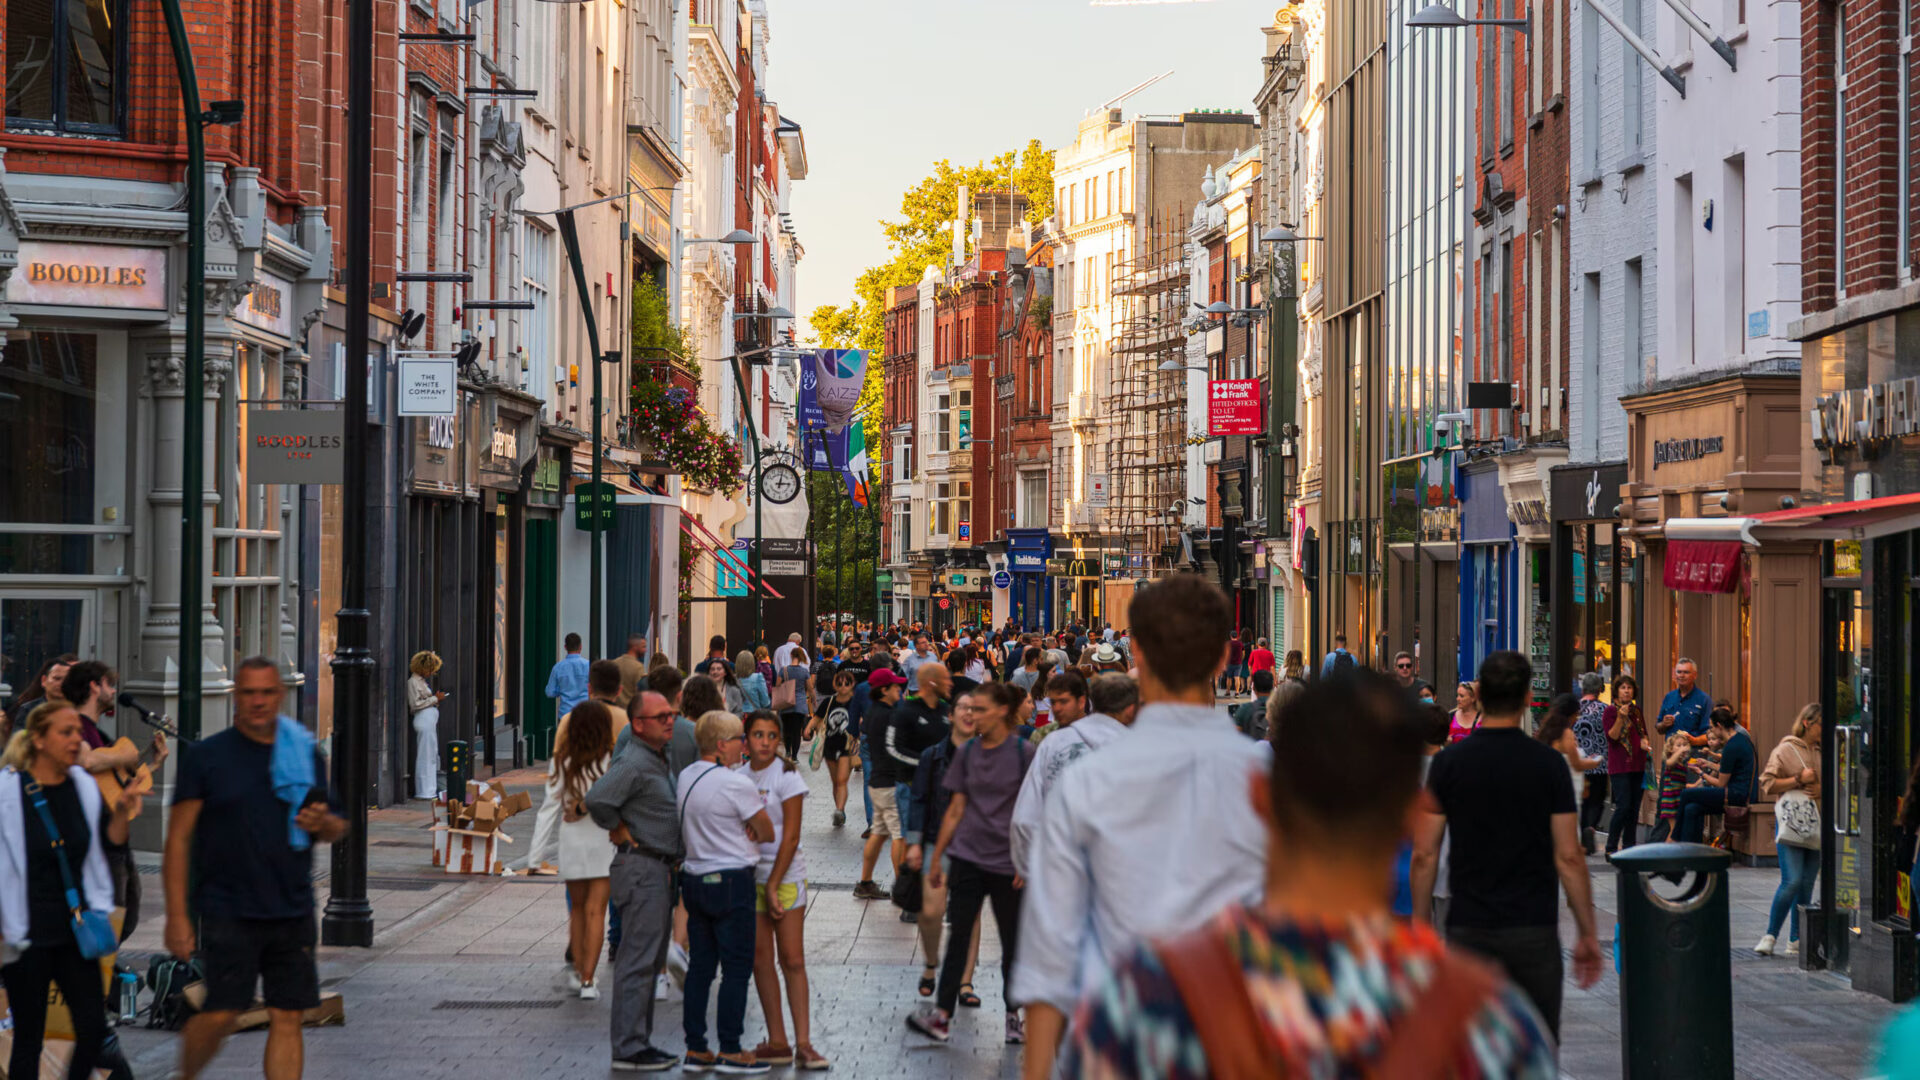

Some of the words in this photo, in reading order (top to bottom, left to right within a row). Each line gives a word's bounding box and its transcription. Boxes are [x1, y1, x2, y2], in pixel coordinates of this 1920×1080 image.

[31, 262, 147, 287] BOODLES
[1228, 382, 1252, 390] Knight
[818, 386, 861, 400] KAIZE
[257, 435, 341, 448] BOODLES
